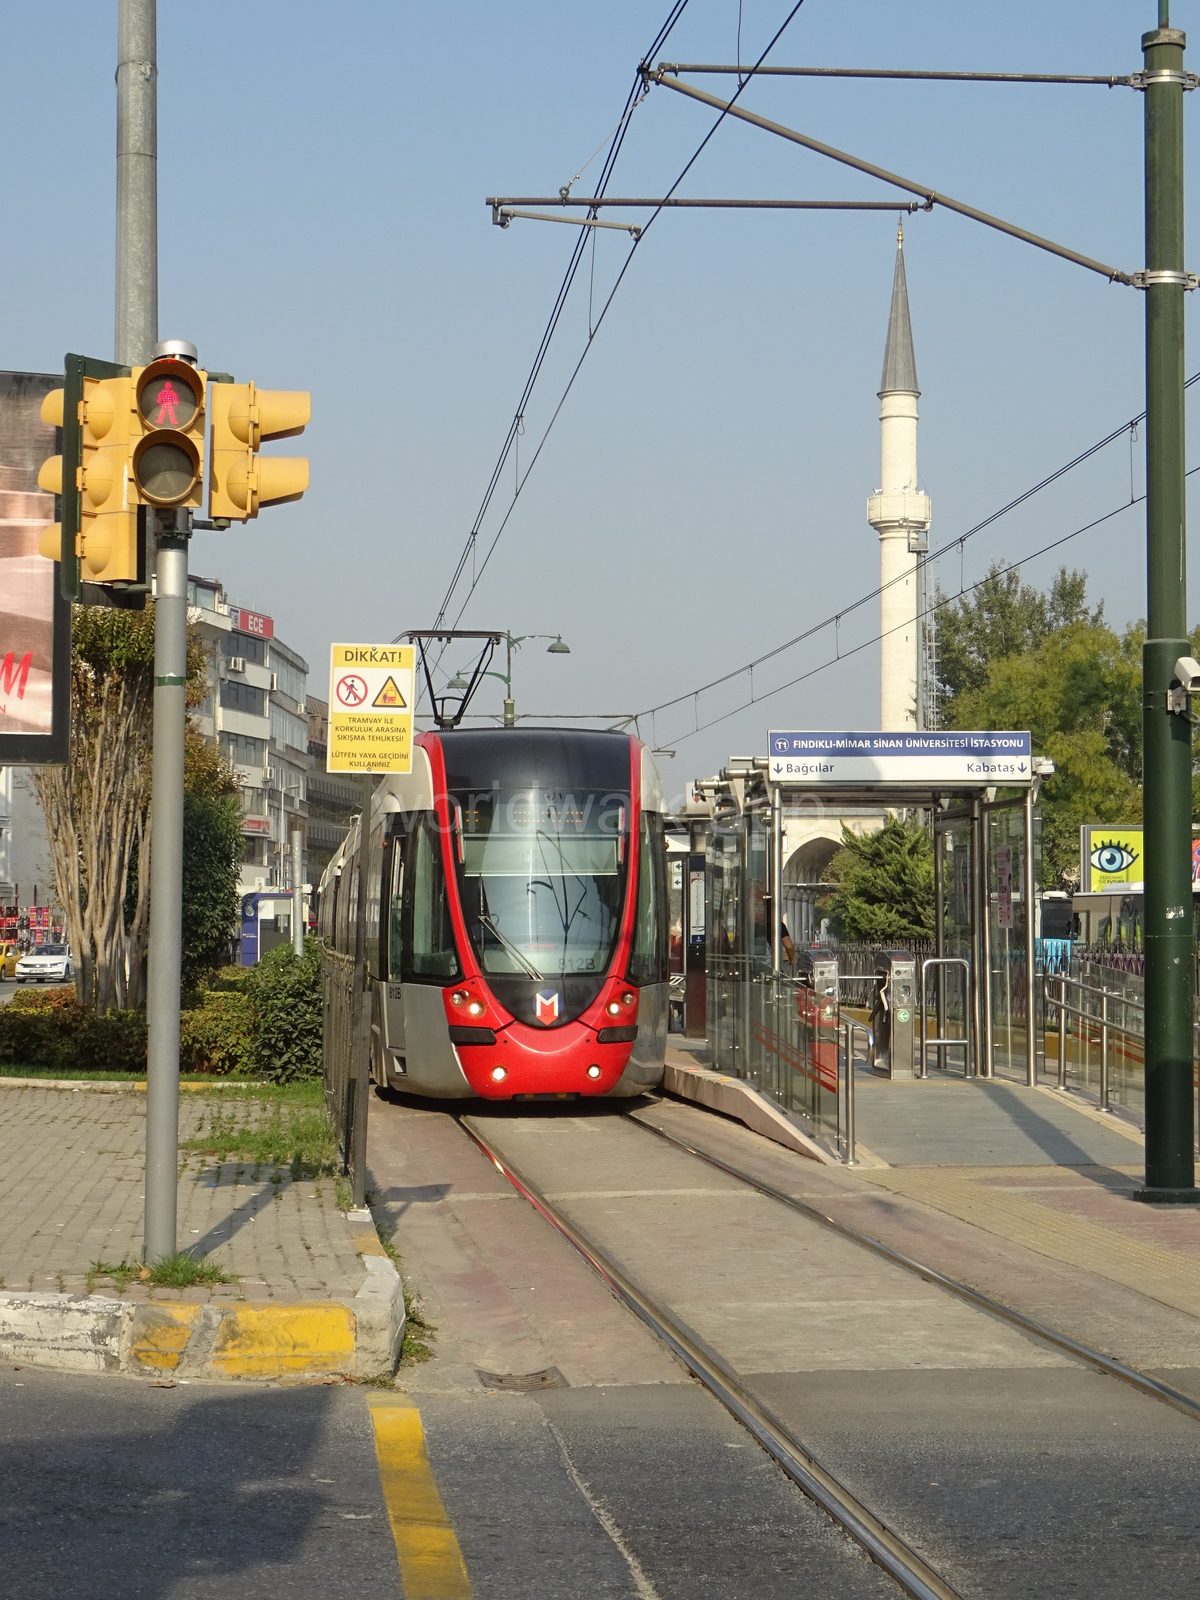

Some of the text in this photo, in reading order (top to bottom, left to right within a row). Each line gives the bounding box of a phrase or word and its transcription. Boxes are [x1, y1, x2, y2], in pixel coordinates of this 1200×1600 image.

[248, 614, 264, 634] ECE
[344, 648, 402, 663] DİKKAT!
[348, 717, 394, 725] TRAMVAY İLE
[337, 734, 366, 742] SIKIŞMA
[776, 738, 1024, 750] T1 FINDIKLI-MİMAR SİNAN ÜNİVERSİTESİ İSTASYONU
[332, 751, 409, 761] LÜTFEN YAYA GEÇİDİNİ
[786, 763, 835, 775] Bağcılar
[967, 762, 1015, 774] Kabataş
[558, 958, 596, 971] 812B
